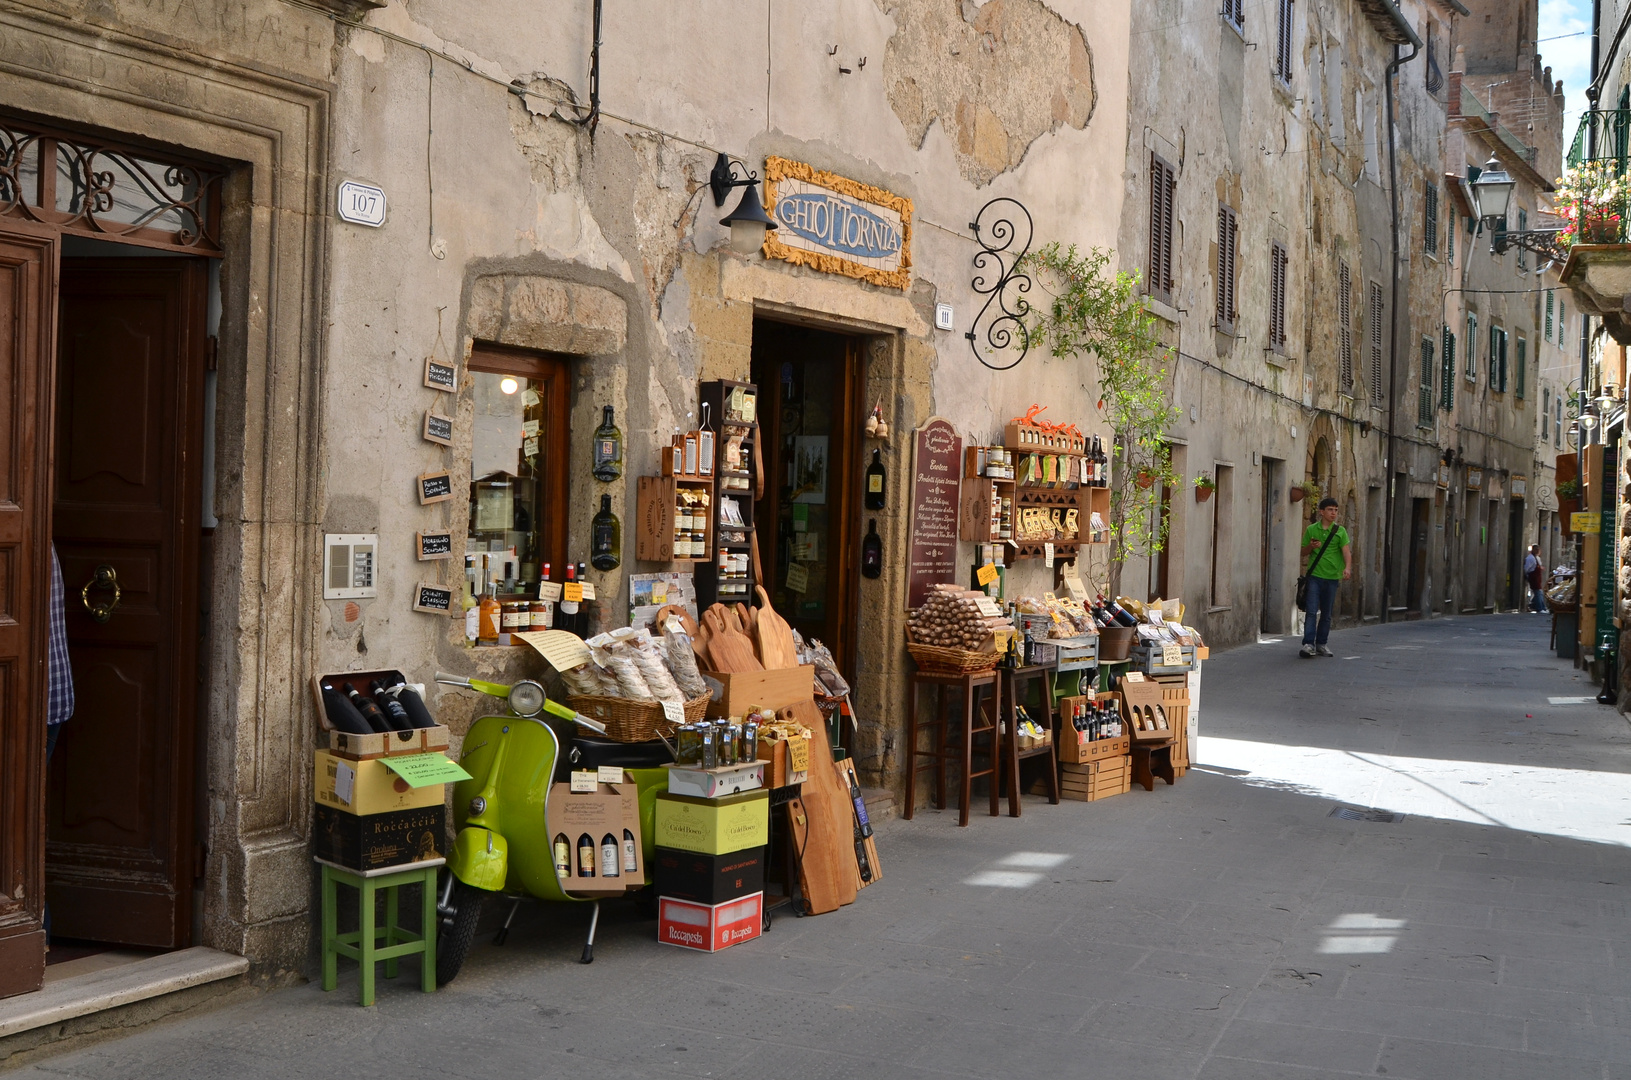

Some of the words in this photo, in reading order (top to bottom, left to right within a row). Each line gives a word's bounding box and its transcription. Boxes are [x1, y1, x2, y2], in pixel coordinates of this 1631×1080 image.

[352, 194, 376, 214] 107
[778, 196, 898, 252] GHIOTTORNIA
[930, 459, 948, 472] Enoteca
[917, 473, 935, 483] Prodotti
[646, 499, 656, 536] BOLGHERI
[656, 497, 667, 539] ORNELLAIA
[374, 816, 436, 834] Roccaccia
[668, 925, 703, 944] Roccapesta
[731, 926, 752, 940] Roccapesta
